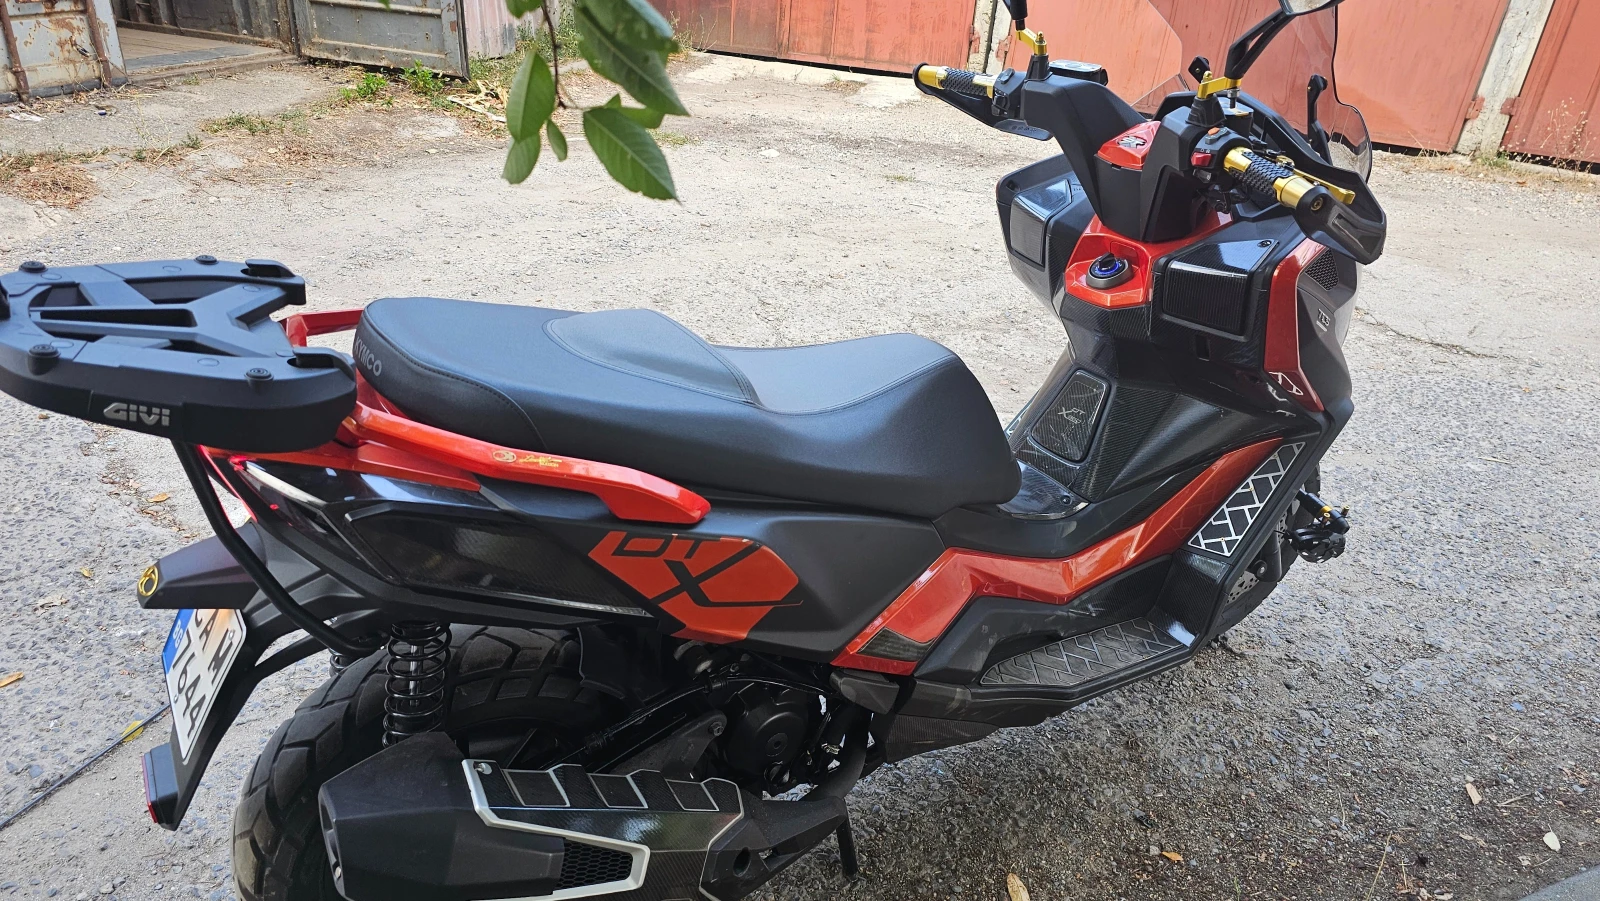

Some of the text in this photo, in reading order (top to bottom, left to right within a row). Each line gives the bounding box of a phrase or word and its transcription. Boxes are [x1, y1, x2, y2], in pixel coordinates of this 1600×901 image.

[103, 402, 170, 427] GIVI
[172, 618, 184, 650] BG
[172, 629, 207, 739] 7644
